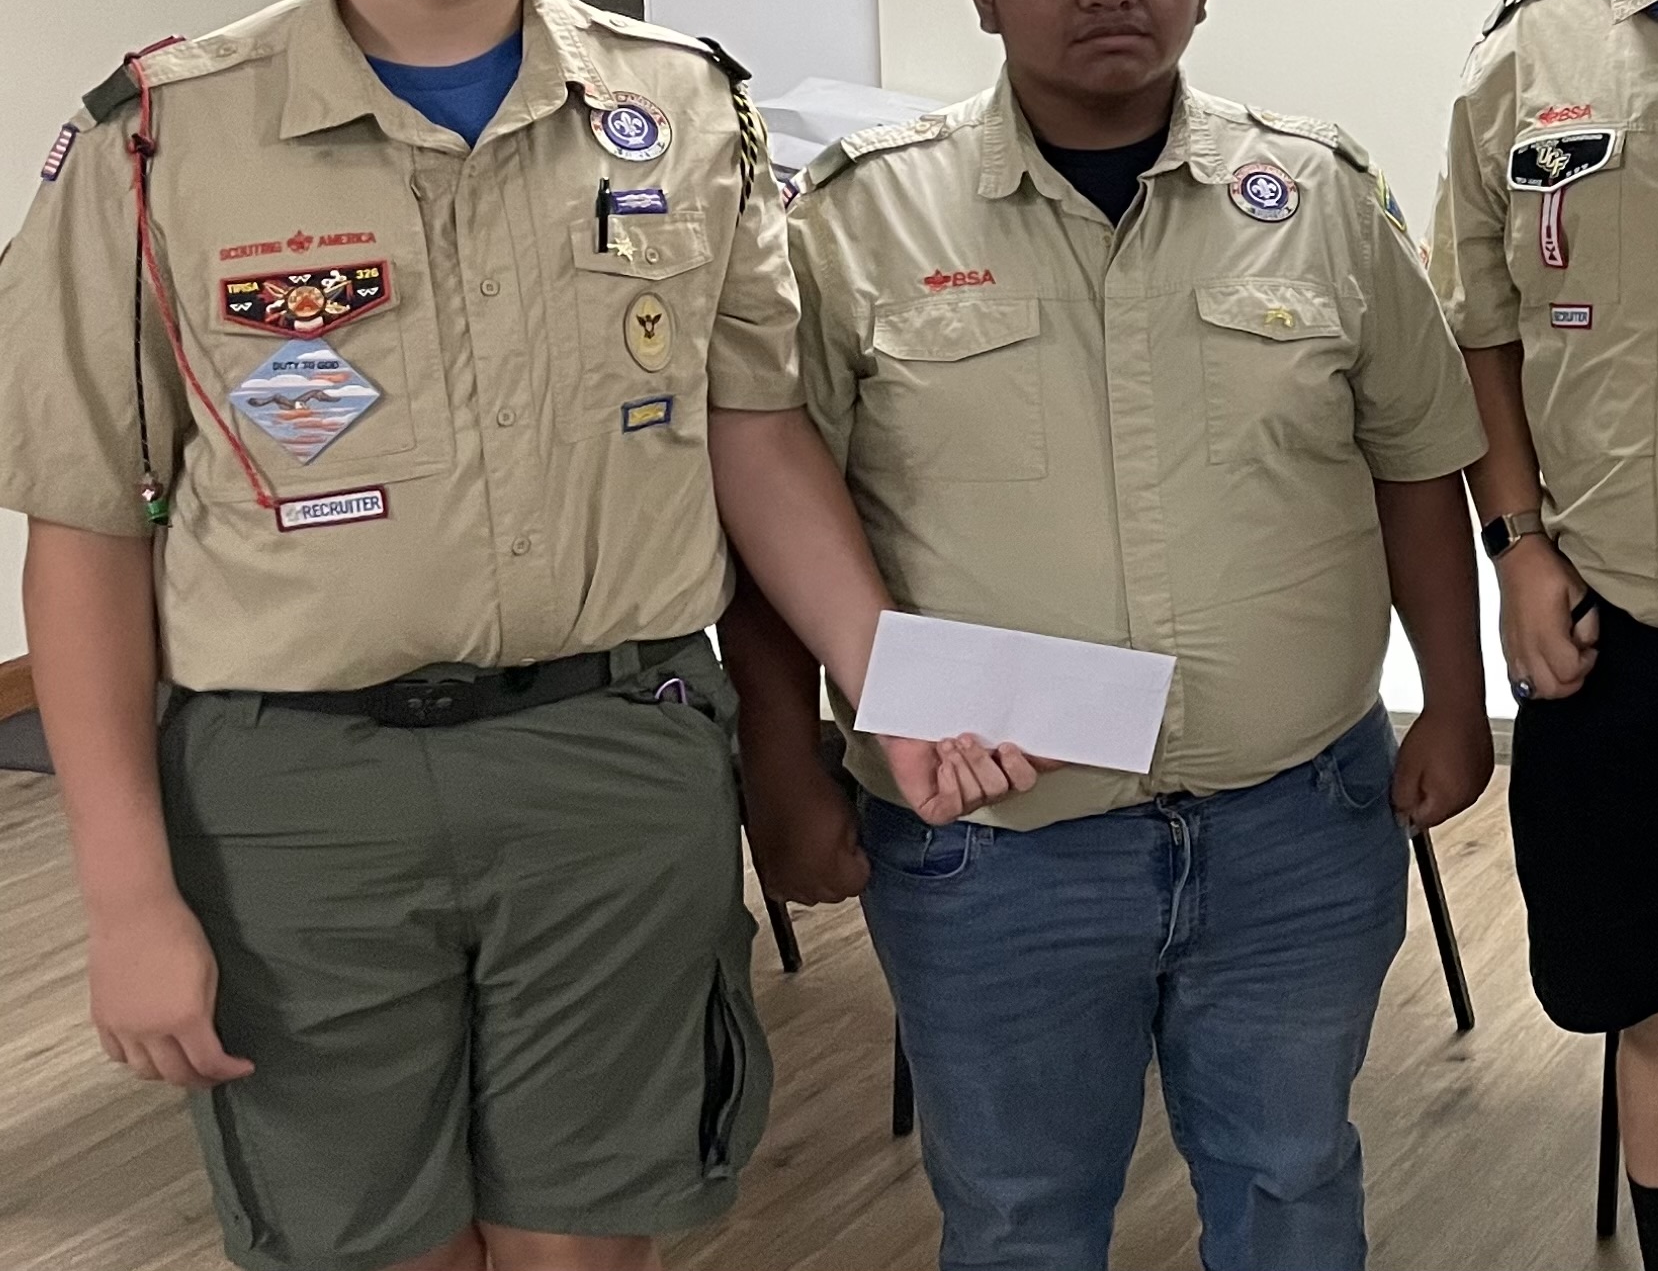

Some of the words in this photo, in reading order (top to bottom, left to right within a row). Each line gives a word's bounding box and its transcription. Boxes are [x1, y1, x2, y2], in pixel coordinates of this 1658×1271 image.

[1538, 146, 1569, 177] UCF
[952, 269, 997, 287] BSA
[301, 495, 382, 520] RECRUITER
